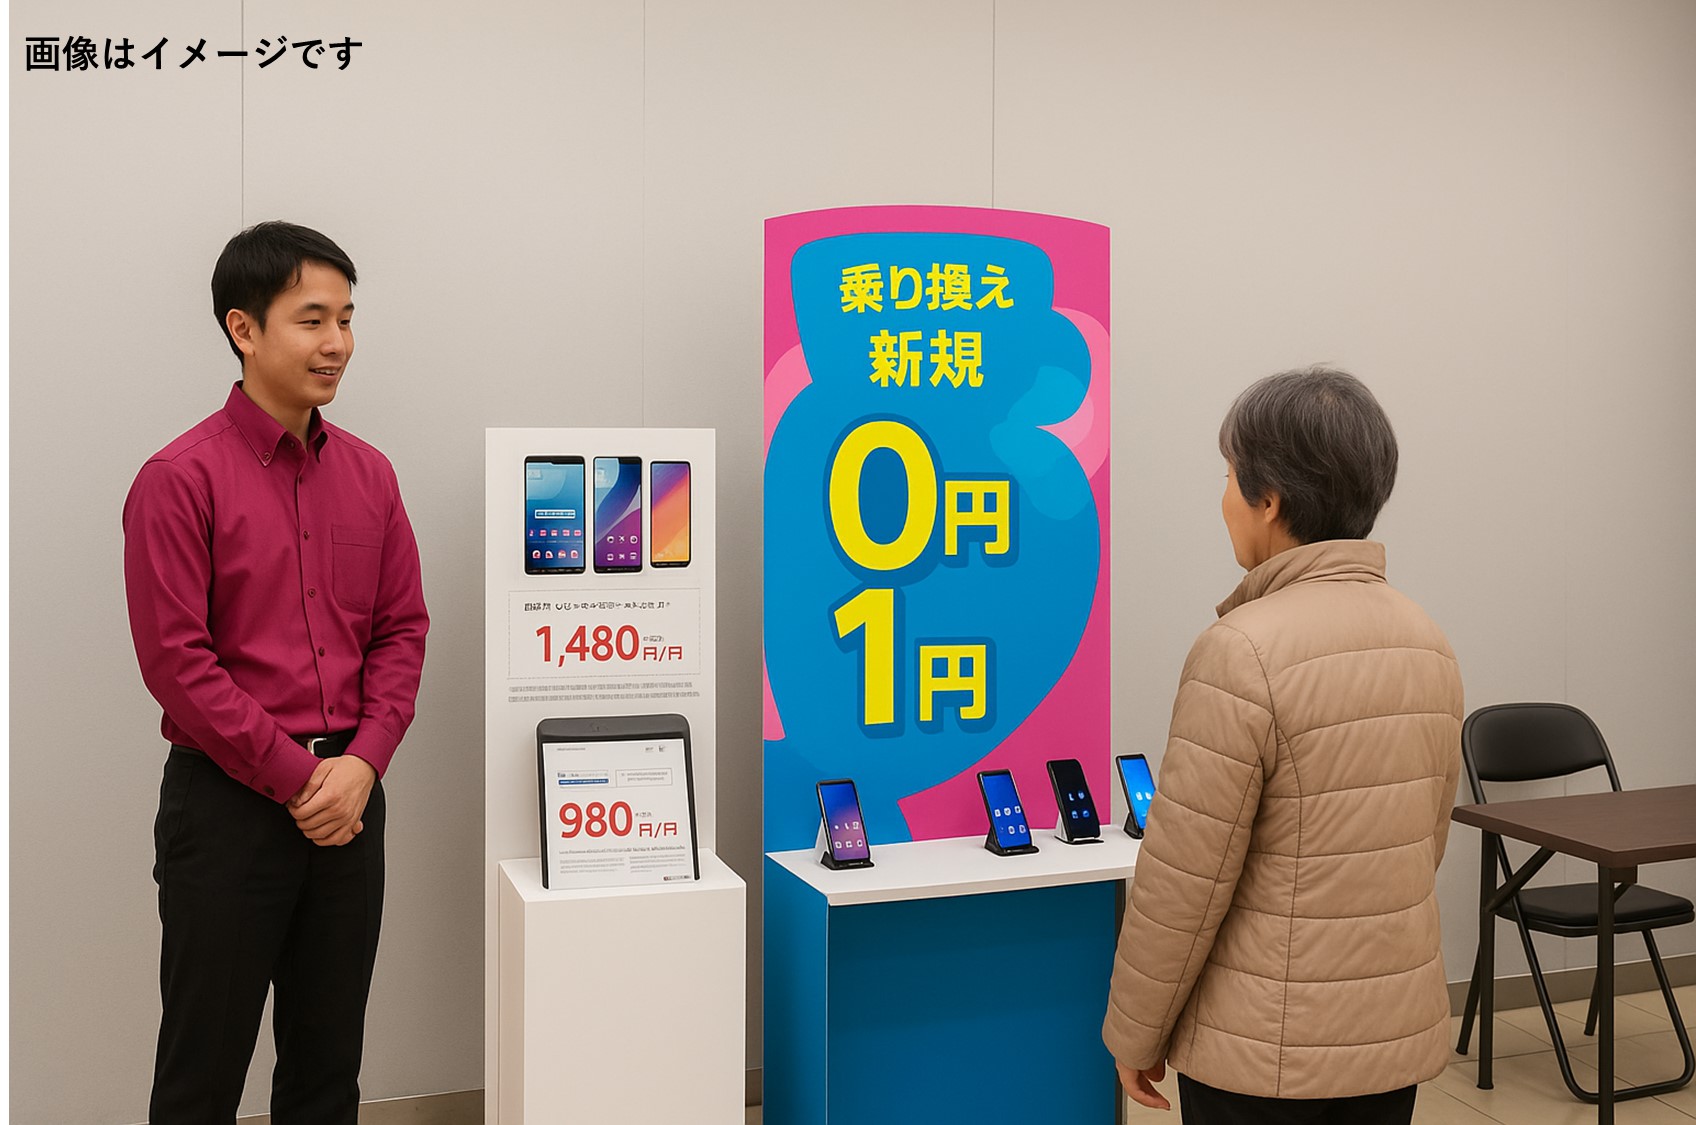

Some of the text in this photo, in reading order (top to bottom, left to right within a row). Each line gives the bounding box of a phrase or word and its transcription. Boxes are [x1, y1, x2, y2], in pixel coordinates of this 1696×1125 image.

[839, 263, 1014, 313] 乗り換え
[868, 329, 984, 388] 新規
[829, 420, 1010, 571] 0円
[834, 588, 986, 725] 1円
